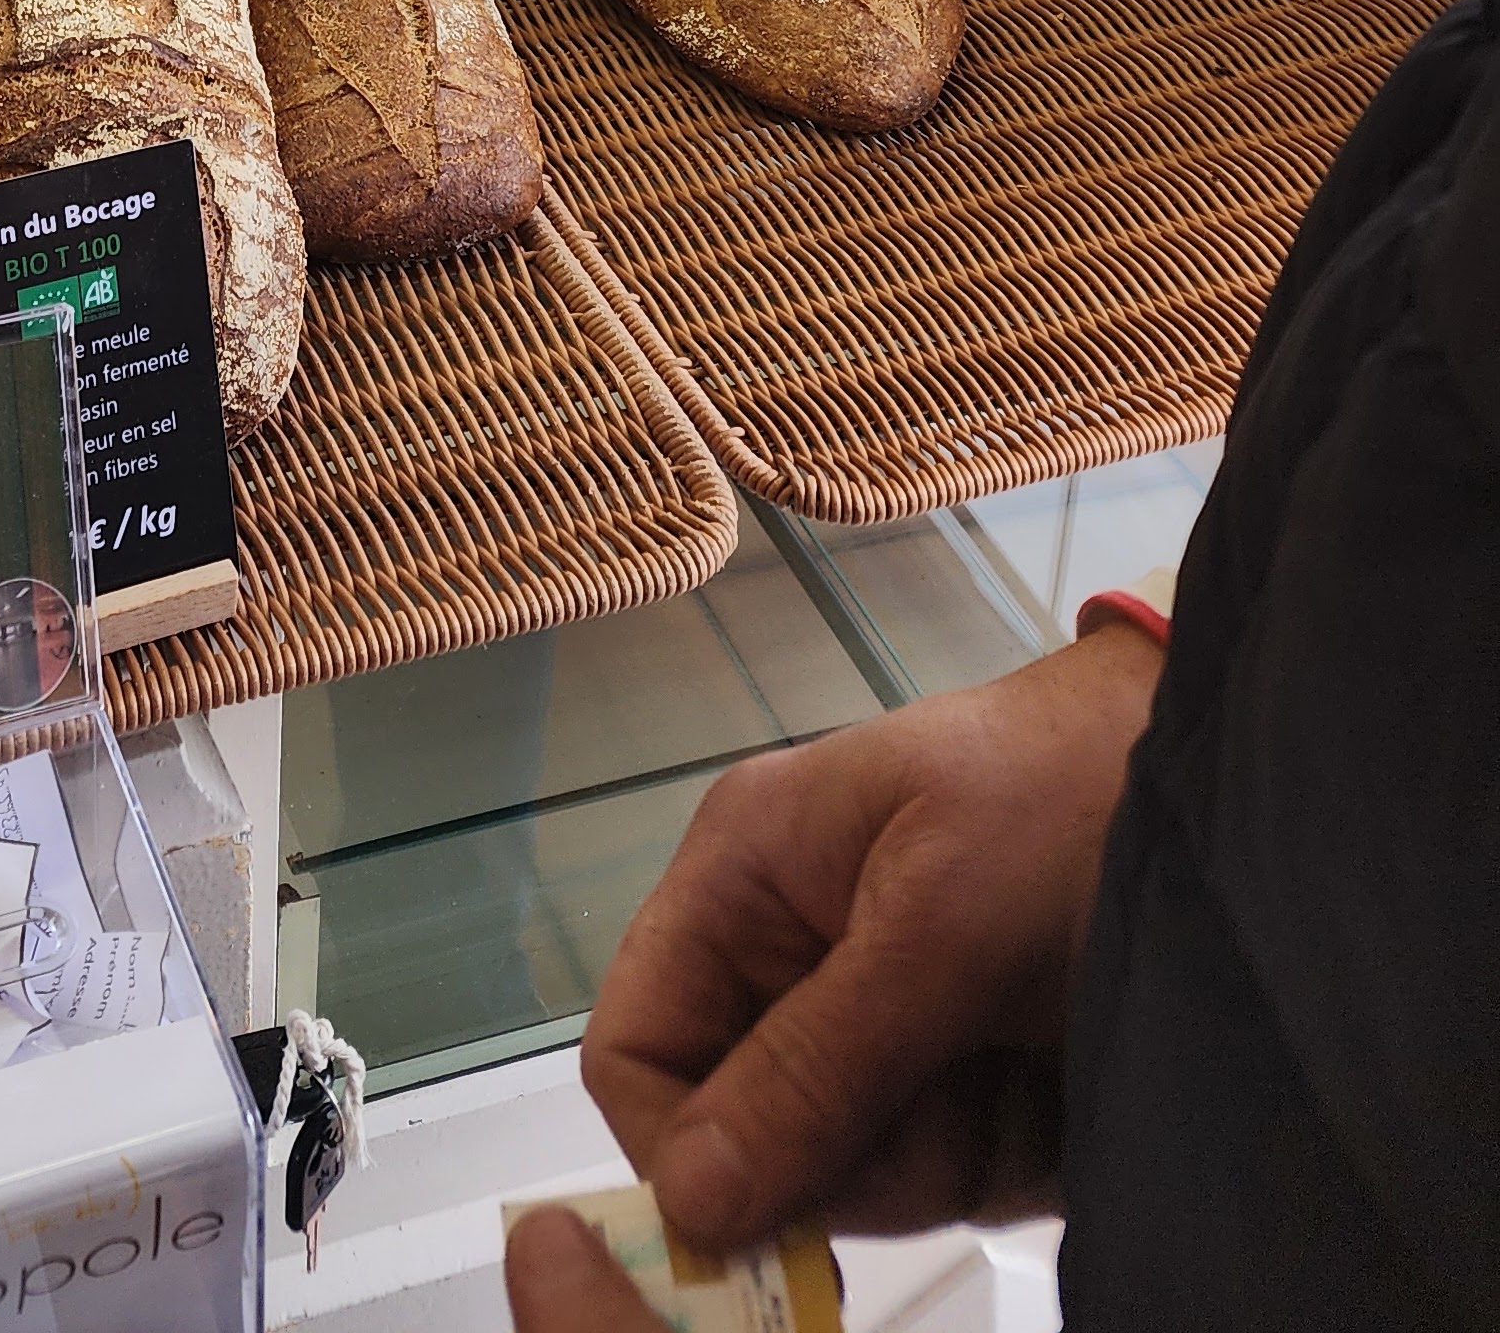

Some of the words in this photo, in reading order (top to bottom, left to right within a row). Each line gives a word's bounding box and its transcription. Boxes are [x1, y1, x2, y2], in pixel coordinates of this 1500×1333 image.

[23, 212, 58, 238] du
[65, 188, 157, 230] Bocage
[4, 253, 50, 284] BIO
[54, 245, 69, 270] T
[78, 233, 122, 266] 100
[84, 278, 115, 308] AB
[91, 323, 151, 355] meule
[102, 342, 190, 384] fermenté
[121, 424, 146, 444] en
[151, 410, 177, 436] sel
[104, 452, 159, 482] fibres
[140, 503, 177, 538] kg
[68, 936, 97, 1019] Adresse
[94, 936, 120, 1020] Prénom
[125, 936, 142, 990] Nom
